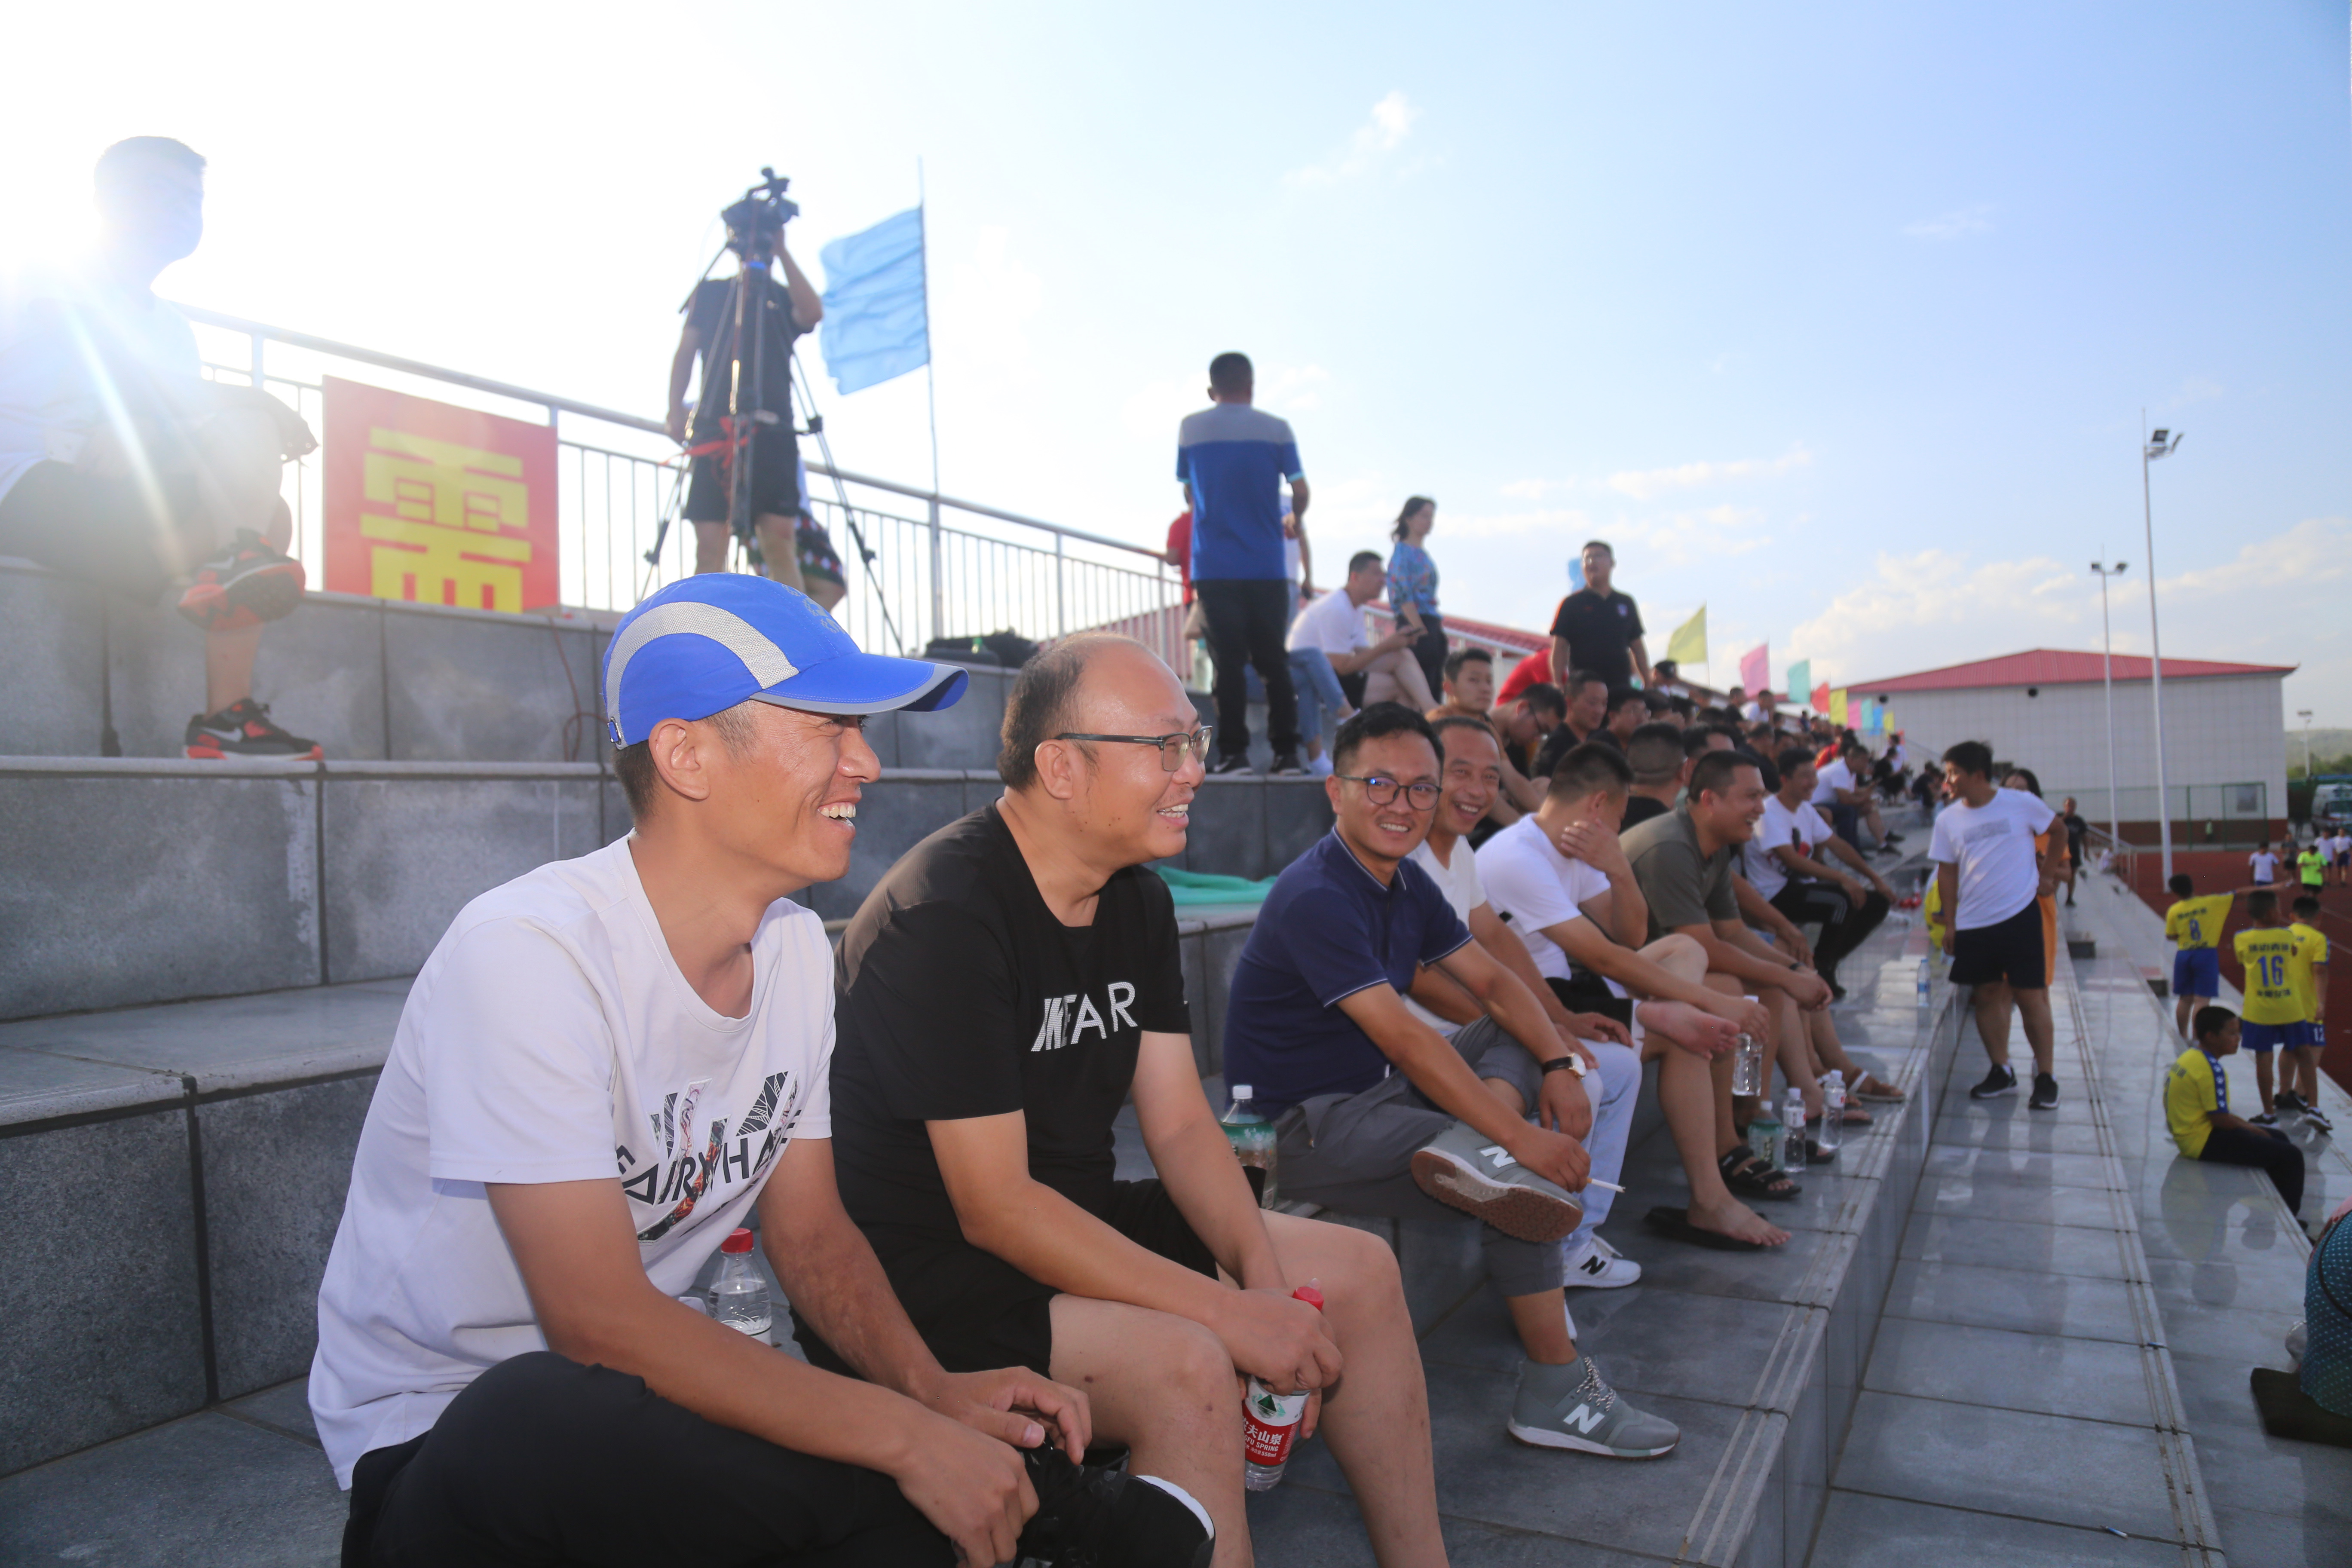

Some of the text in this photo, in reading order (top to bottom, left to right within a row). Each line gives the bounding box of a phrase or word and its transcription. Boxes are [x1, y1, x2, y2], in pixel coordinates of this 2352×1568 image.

[360, 426, 532, 614] 需
[2190, 919, 2202, 941] 8
[2258, 955, 2283, 987] 16
[1480, 1146, 1516, 1168] N
[1580, 1255, 1607, 1276] N
[1563, 1403, 1605, 1434] N
[1256, 1442, 1279, 1452] SPRING
